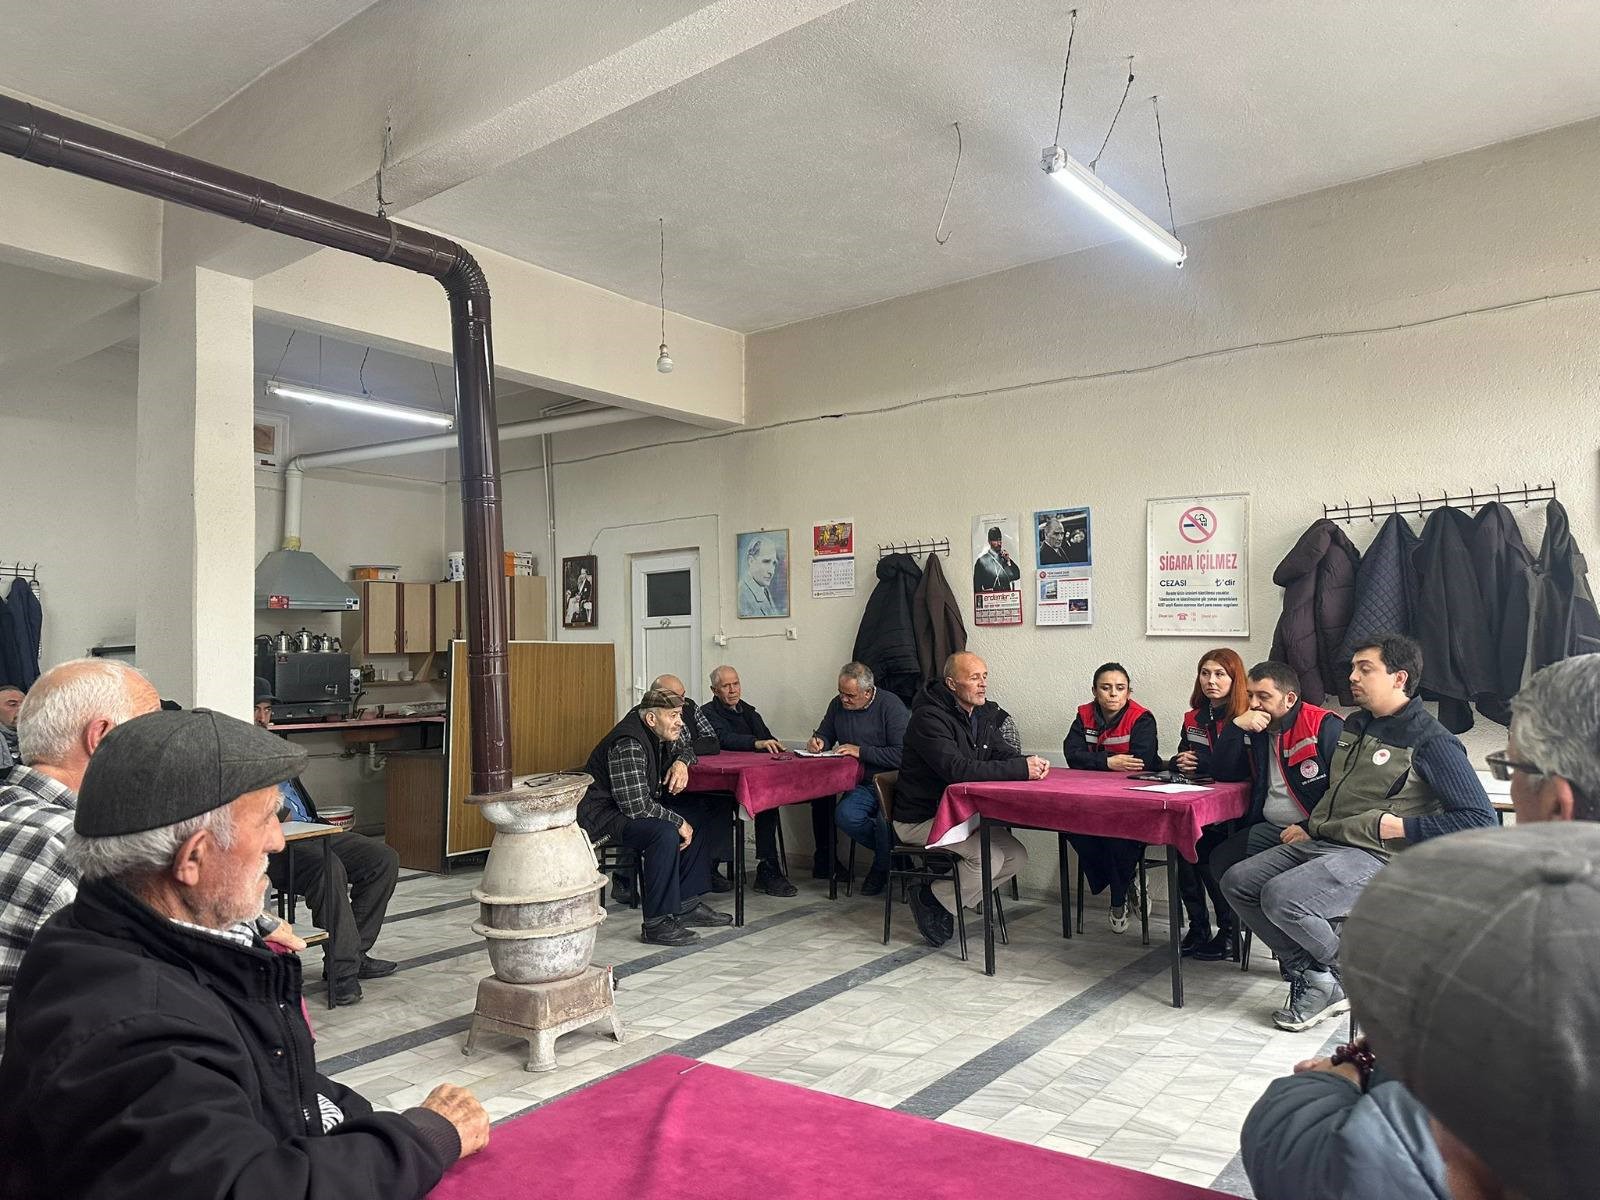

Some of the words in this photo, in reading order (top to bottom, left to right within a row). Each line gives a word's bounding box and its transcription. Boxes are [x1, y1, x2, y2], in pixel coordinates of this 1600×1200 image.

[1159, 551, 1194, 571] SİGARA
[1196, 549, 1238, 574] İÇİLMEZ
[1159, 579, 1187, 587] CEZASI
